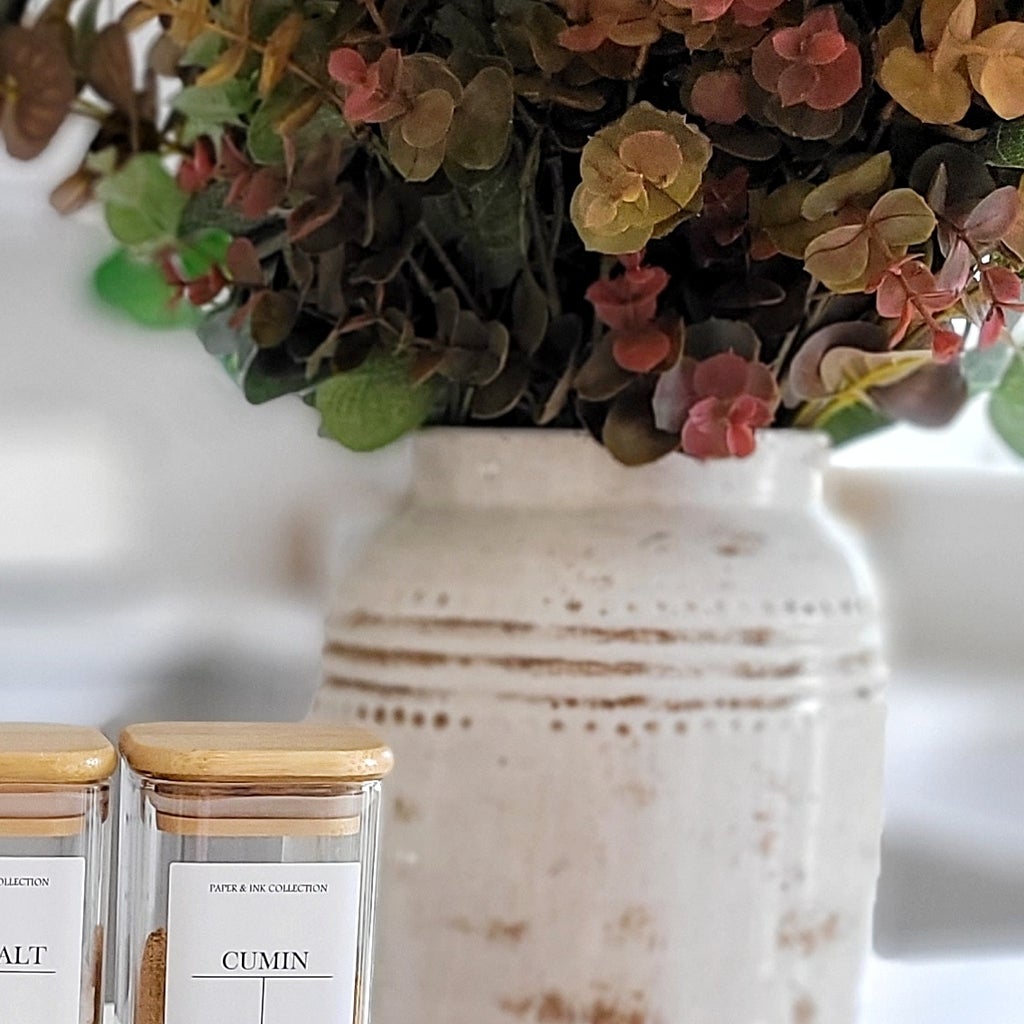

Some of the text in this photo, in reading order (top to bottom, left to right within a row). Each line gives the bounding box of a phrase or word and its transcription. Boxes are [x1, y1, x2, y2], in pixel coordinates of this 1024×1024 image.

[208, 883, 329, 893] PAPER & INK COLLECTION
[223, 951, 309, 970] CUMIN
